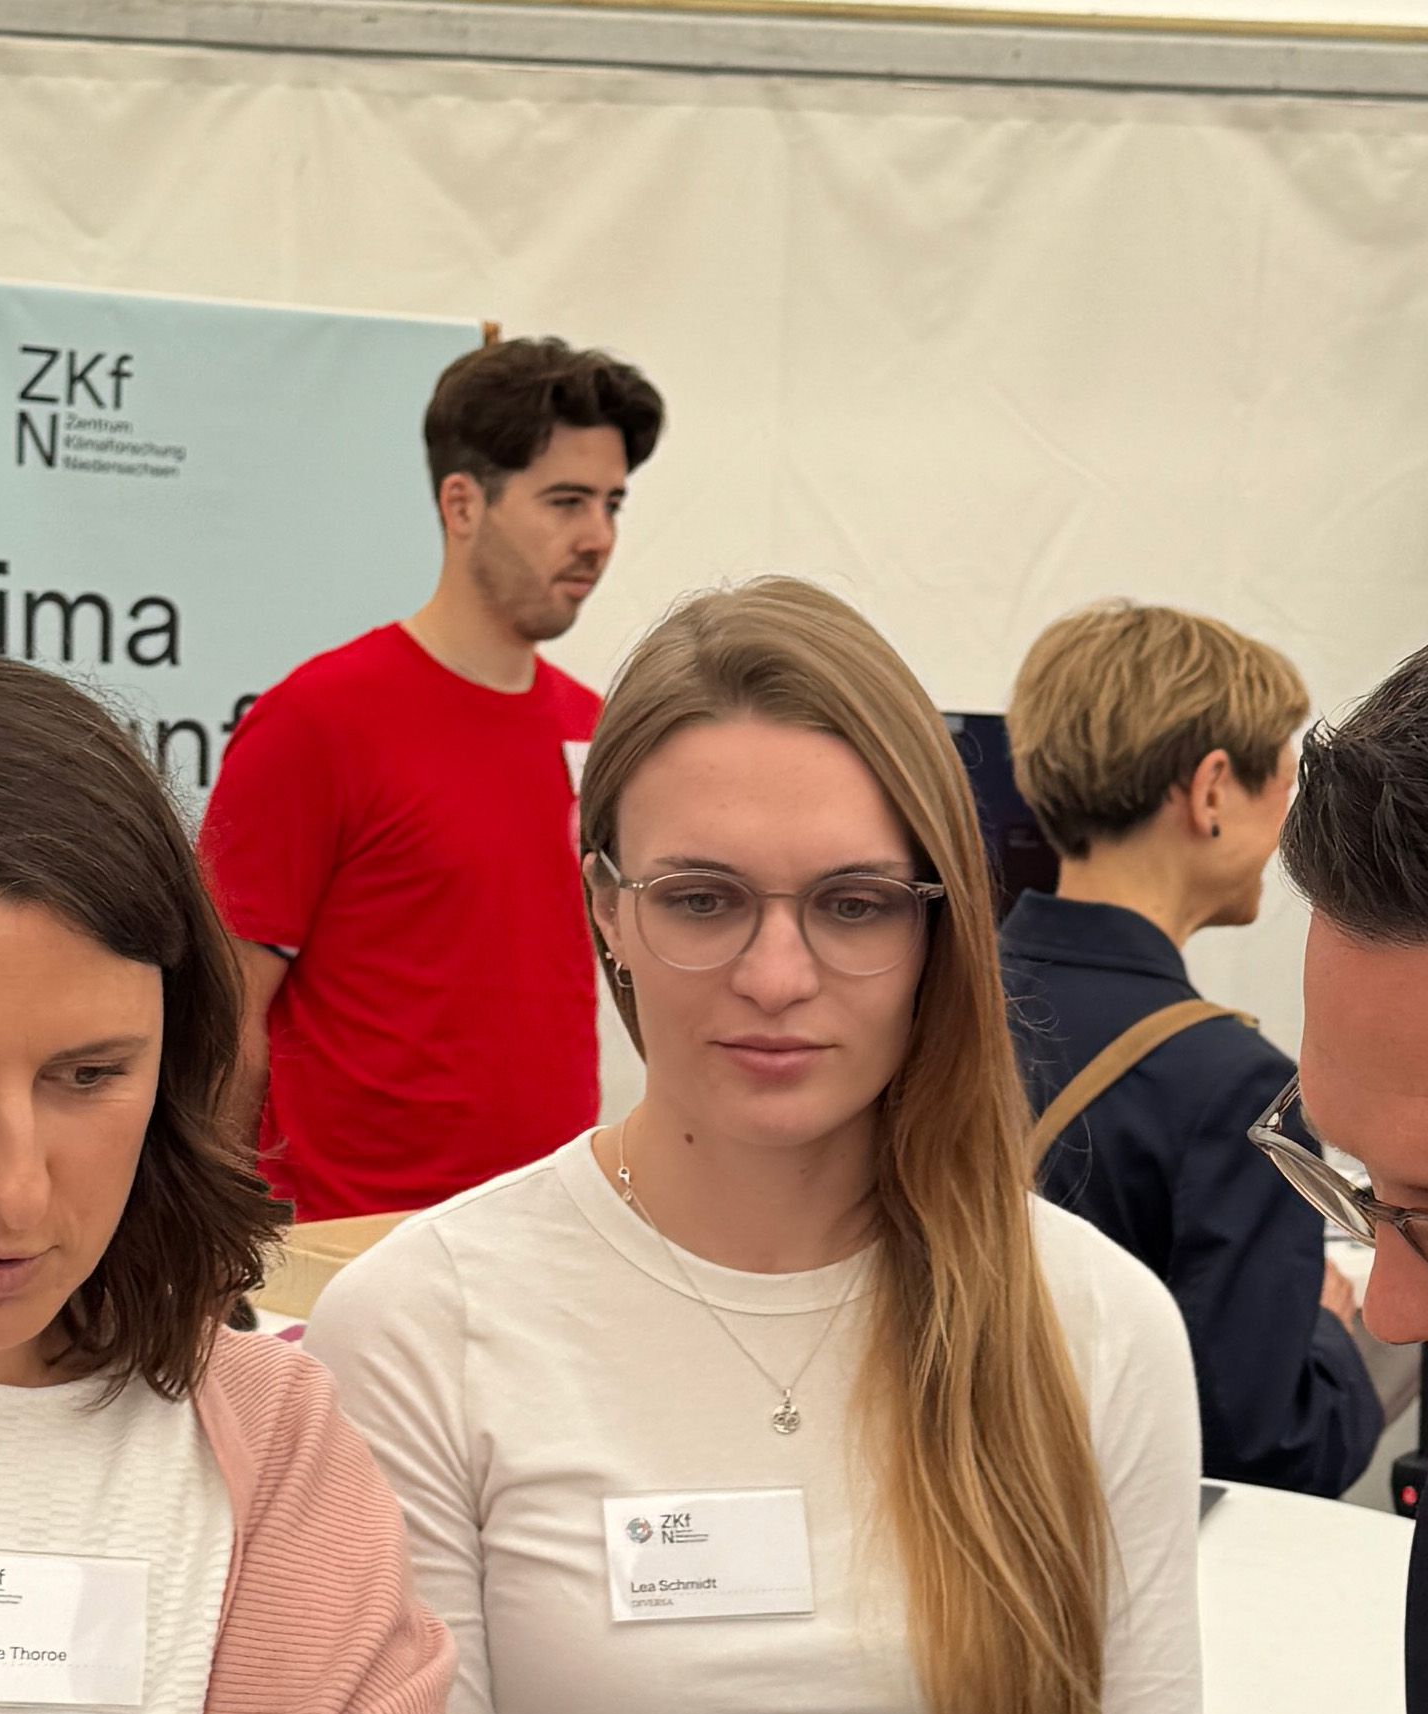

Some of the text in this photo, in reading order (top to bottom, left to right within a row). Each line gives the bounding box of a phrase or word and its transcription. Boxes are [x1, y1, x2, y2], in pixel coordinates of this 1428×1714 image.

[18, 345, 134, 410] ZKf
[16, 411, 133, 468] N Zentrum
[63, 435, 187, 463] Klimaforschung
[660, 1513, 693, 1529] ZKf
[662, 1530, 675, 1544] N
[630, 1578, 718, 1594] Lea Schmidt
[10, 1645, 68, 1662] Thoroe
